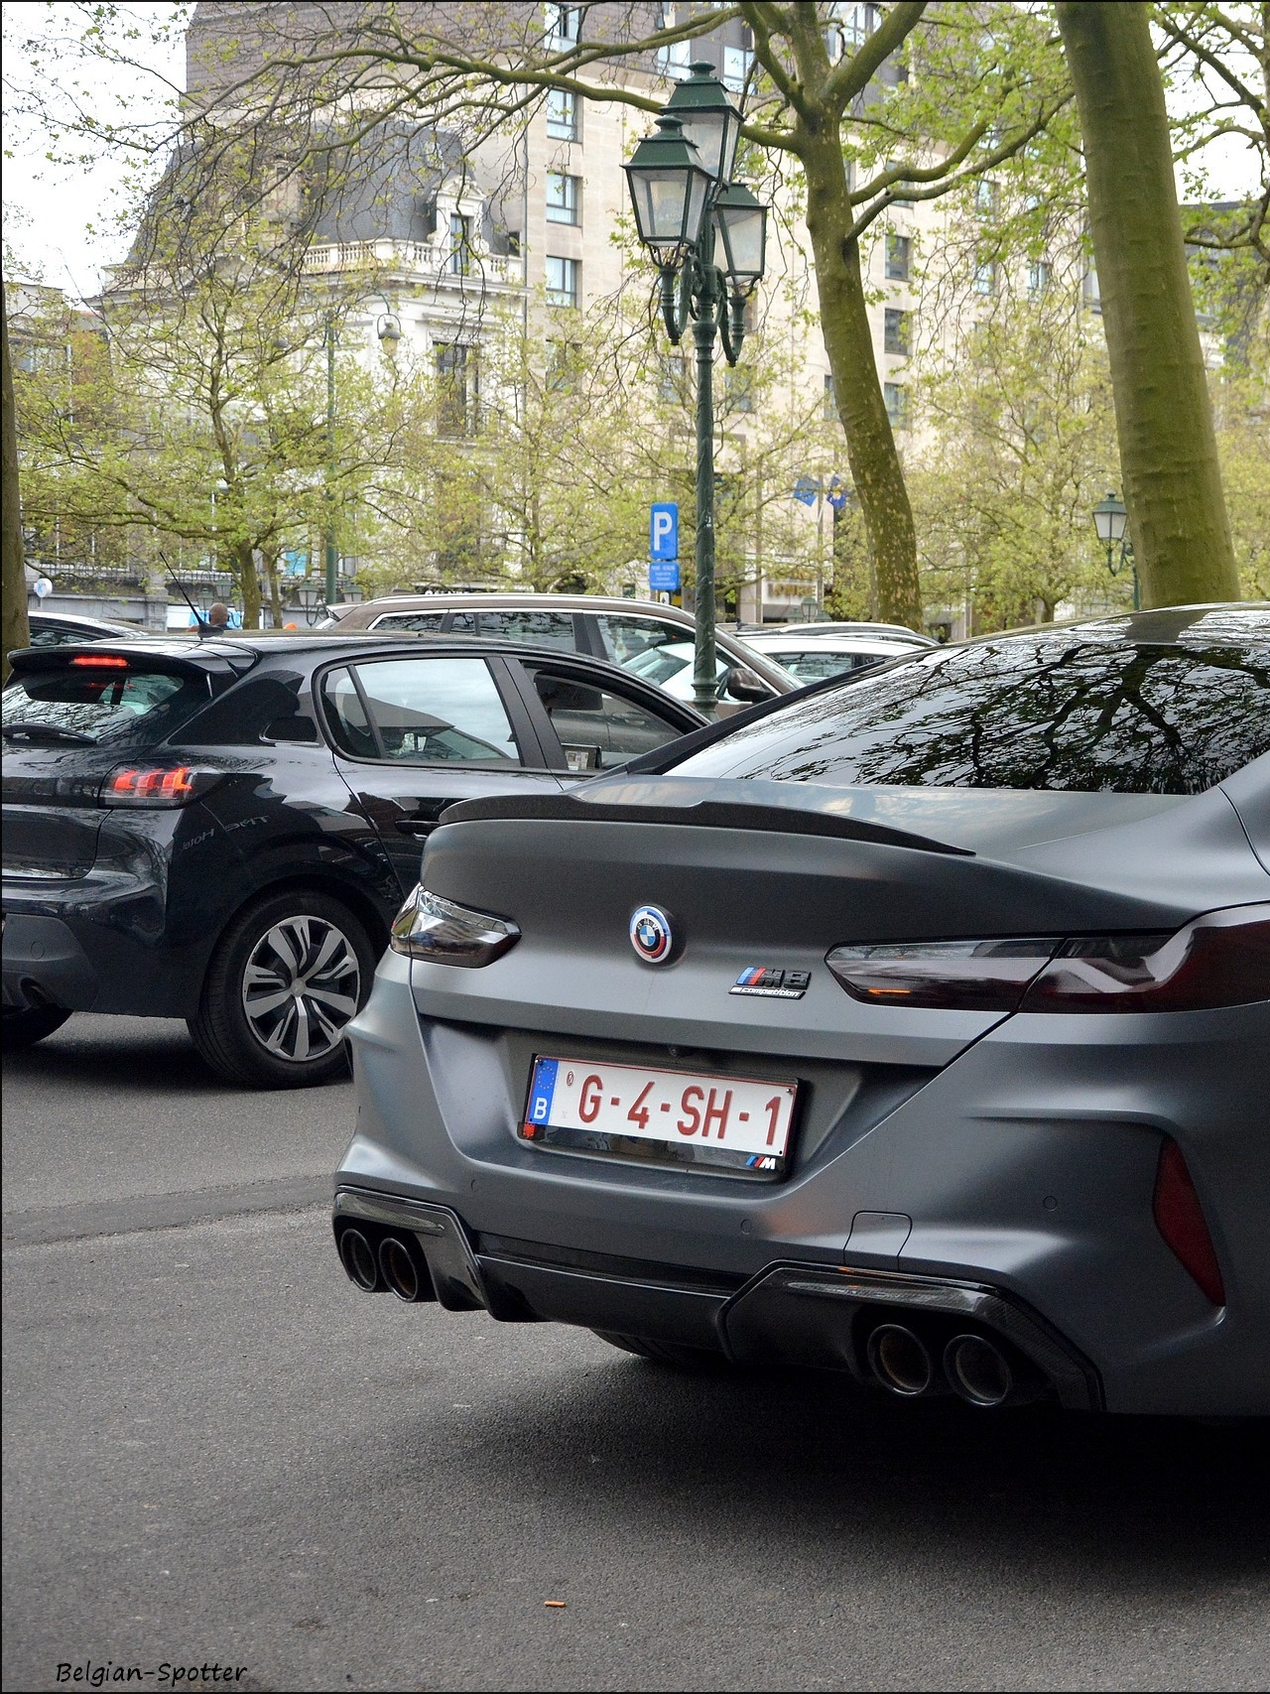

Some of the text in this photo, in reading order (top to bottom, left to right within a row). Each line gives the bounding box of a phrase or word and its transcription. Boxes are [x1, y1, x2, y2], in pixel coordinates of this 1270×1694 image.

[654, 511, 673, 551] P
[636, 917, 659, 932] BMW
[742, 987, 800, 998] competition
[533, 1097, 548, 1119] B
[578, 1074, 782, 1145] G-4-SH-1
